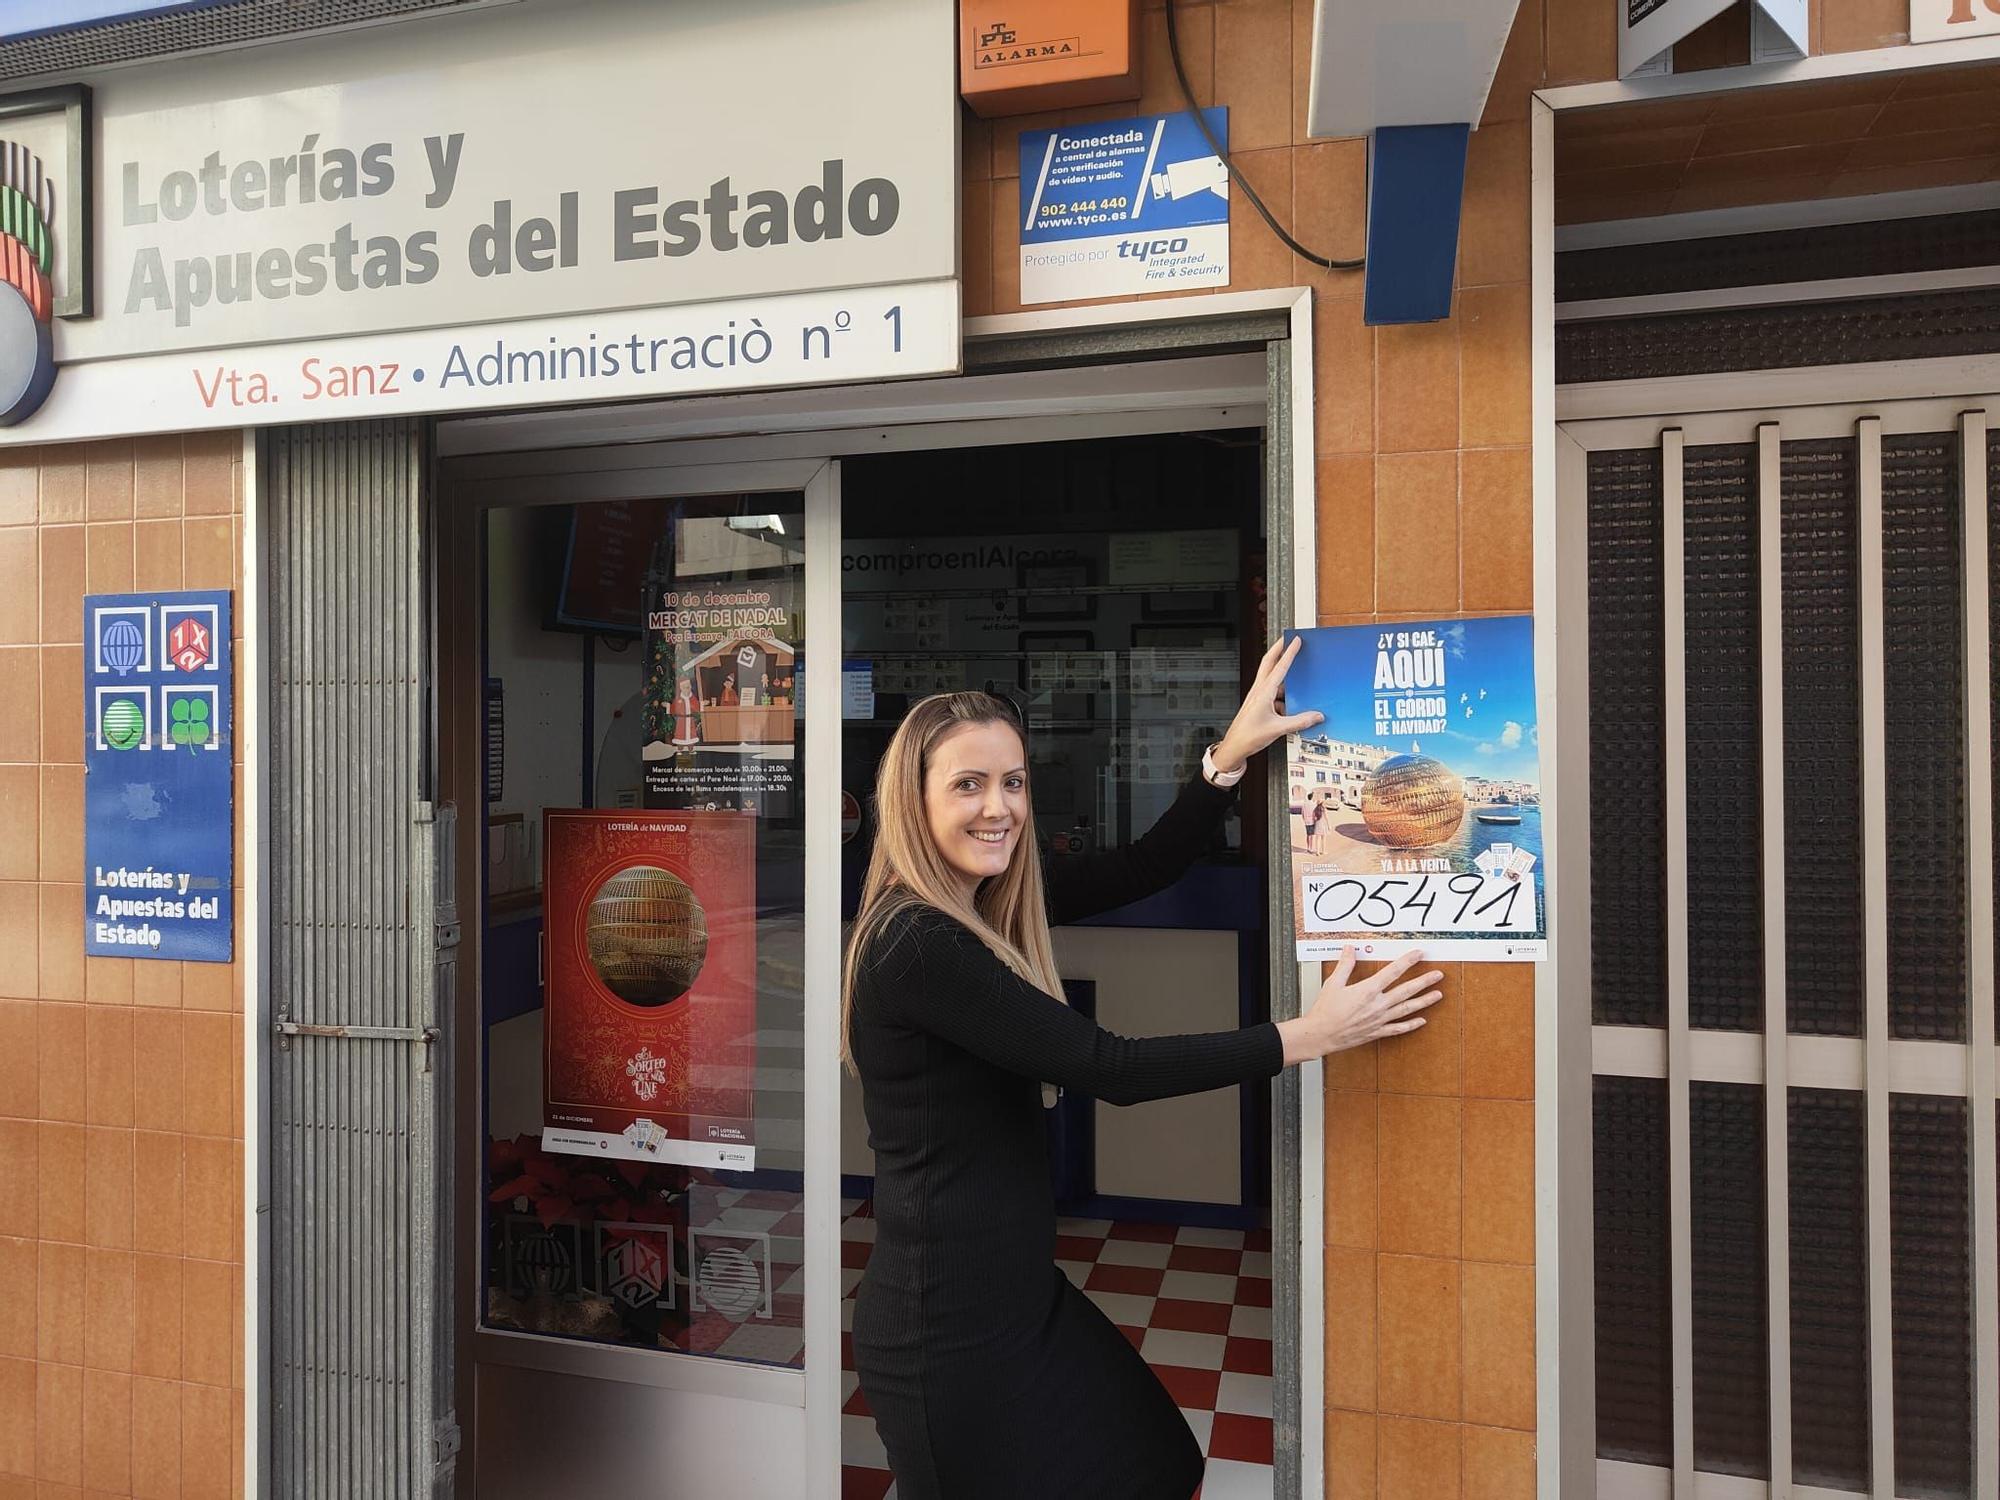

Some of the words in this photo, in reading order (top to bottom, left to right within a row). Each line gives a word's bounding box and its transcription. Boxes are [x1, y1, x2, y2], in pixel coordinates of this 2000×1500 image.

[981, 43, 1072, 63] ALARMA
[1060, 130, 1144, 151] Conectada
[1062, 151, 1095, 163] central
[1095, 150, 1108, 159] de
[1109, 145, 1145, 157] alarmas
[1052, 166, 1069, 175] con
[1070, 159, 1124, 173] verificación
[123, 133, 395, 227] Loterías
[423, 132, 465, 209] y
[1049, 177, 1061, 187] de
[1062, 173, 1087, 186] vídeo
[1088, 174, 1095, 183] y
[1096, 170, 1124, 181] audio.
[1041, 204, 1067, 217] 902
[1070, 200, 1097, 213] 444
[1100, 197, 1127, 210] 440
[1037, 211, 1127, 230] www.tyco.es
[123, 222, 440, 327] Apuestas
[468, 192, 579, 277] del
[613, 159, 900, 261] Estado
[1116, 237, 1188, 262] tyco
[1024, 250, 1085, 267] Protegido
[1088, 249, 1110, 261] por
[1149, 253, 1206, 268] Integrated
[1145, 269, 1165, 280] Fire
[1167, 267, 1176, 277] &
[1179, 264, 1224, 277] Security
[192, 366, 278, 408] Vta.
[302, 358, 399, 400] Sanz
[440, 318, 773, 388] Administraciò
[802, 310, 851, 360] nº
[884, 305, 902, 353] 1
[663, 592, 679, 607] 10
[682, 591, 700, 607] de
[704, 589, 770, 606] desembre
[649, 610, 708, 629] MERCAT
[710, 609, 731, 627] DE
[733, 607, 787, 626] NADAL
[174, 626, 183, 649] 1
[192, 623, 206, 651] X
[665, 631, 682, 644] Pça
[1377, 633, 1394, 649] ¿Y
[1397, 632, 1410, 648] SI
[1412, 630, 1436, 648] CAE
[180, 651, 203, 669] 2
[1374, 640, 1445, 689] AQUÍ
[1374, 699, 1392, 719] EL
[1395, 697, 1447, 718] GORDO
[1375, 721, 1389, 735] DE
[1391, 718, 1447, 734] NAVIDAD?
[607, 821, 639, 831] LOTERÍA
[649, 824, 687, 832] NAVIDAD
[1380, 859, 1394, 871] YA
[1395, 859, 1403, 871] A
[1405, 859, 1417, 871] LA
[1420, 858, 1451, 871] VENTA
[95, 866, 173, 889] Loterías
[178, 873, 190, 895] y
[1309, 882, 1325, 893] Nº
[96, 895, 185, 921] Apuestas
[188, 896, 218, 919] del
[1314, 873, 1521, 927] 05491
[95, 923, 161, 945] Estado
